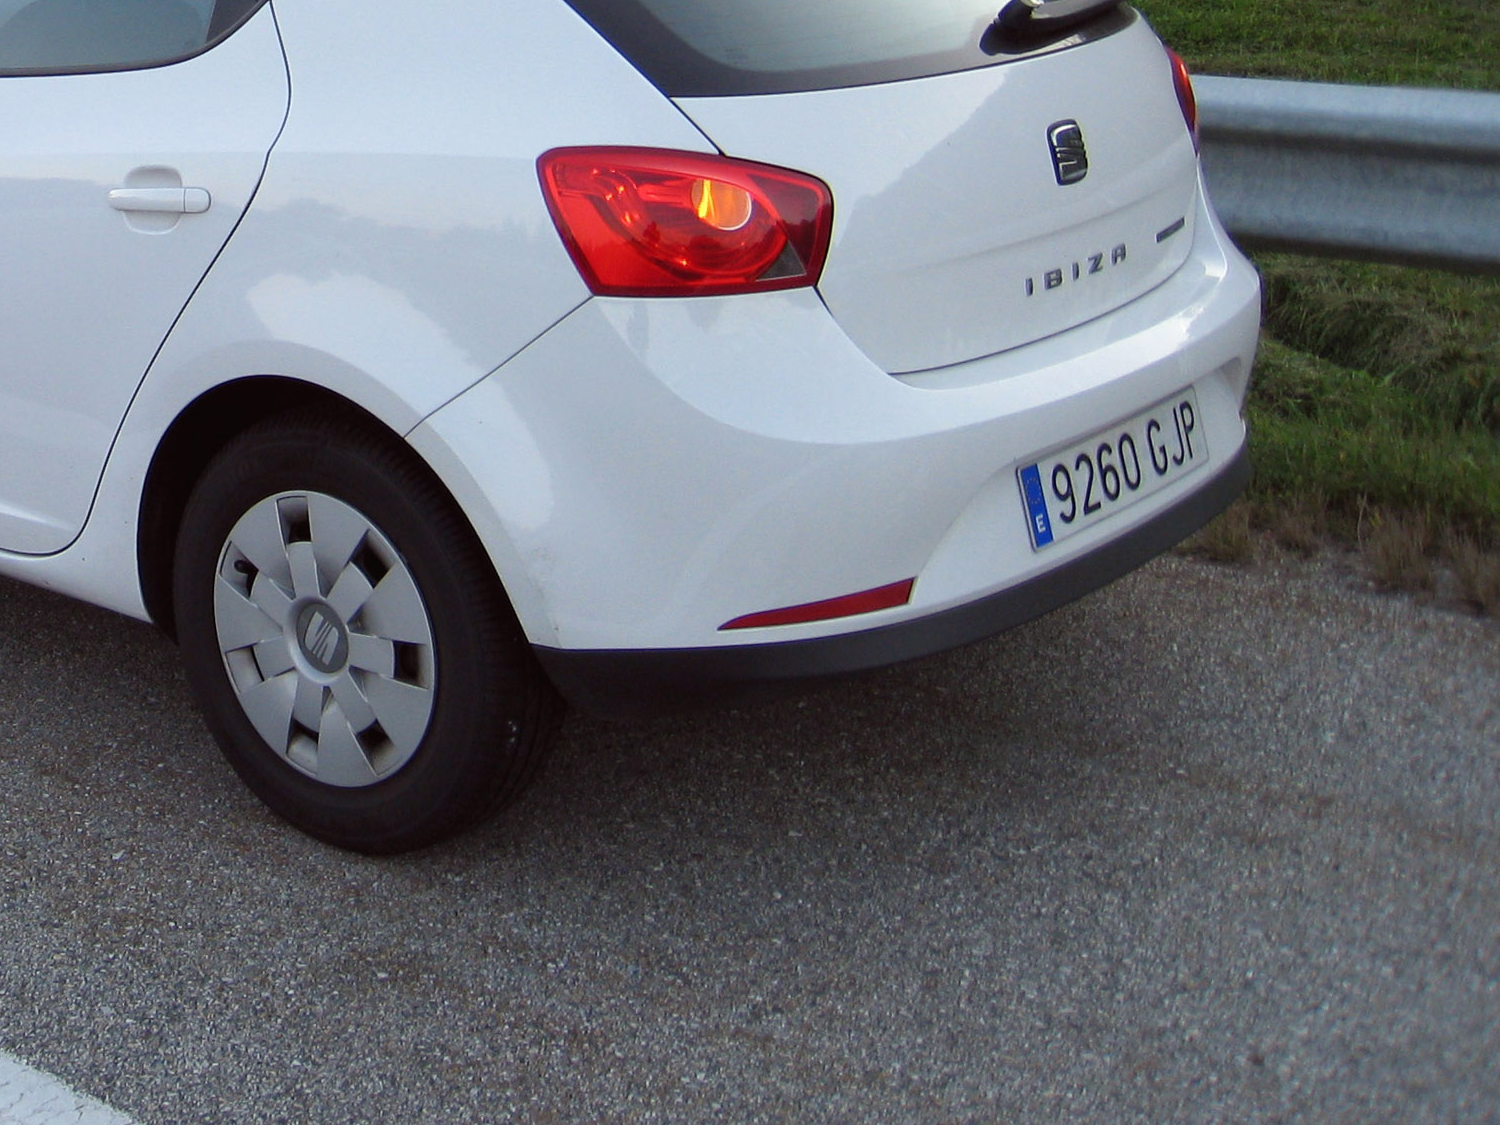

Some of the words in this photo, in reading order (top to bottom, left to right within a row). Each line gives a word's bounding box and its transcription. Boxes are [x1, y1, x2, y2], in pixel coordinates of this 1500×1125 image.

[1025, 243, 1127, 296] IBIZA
[1051, 433, 1142, 524] 9260
[1146, 400, 1195, 475] GJP
